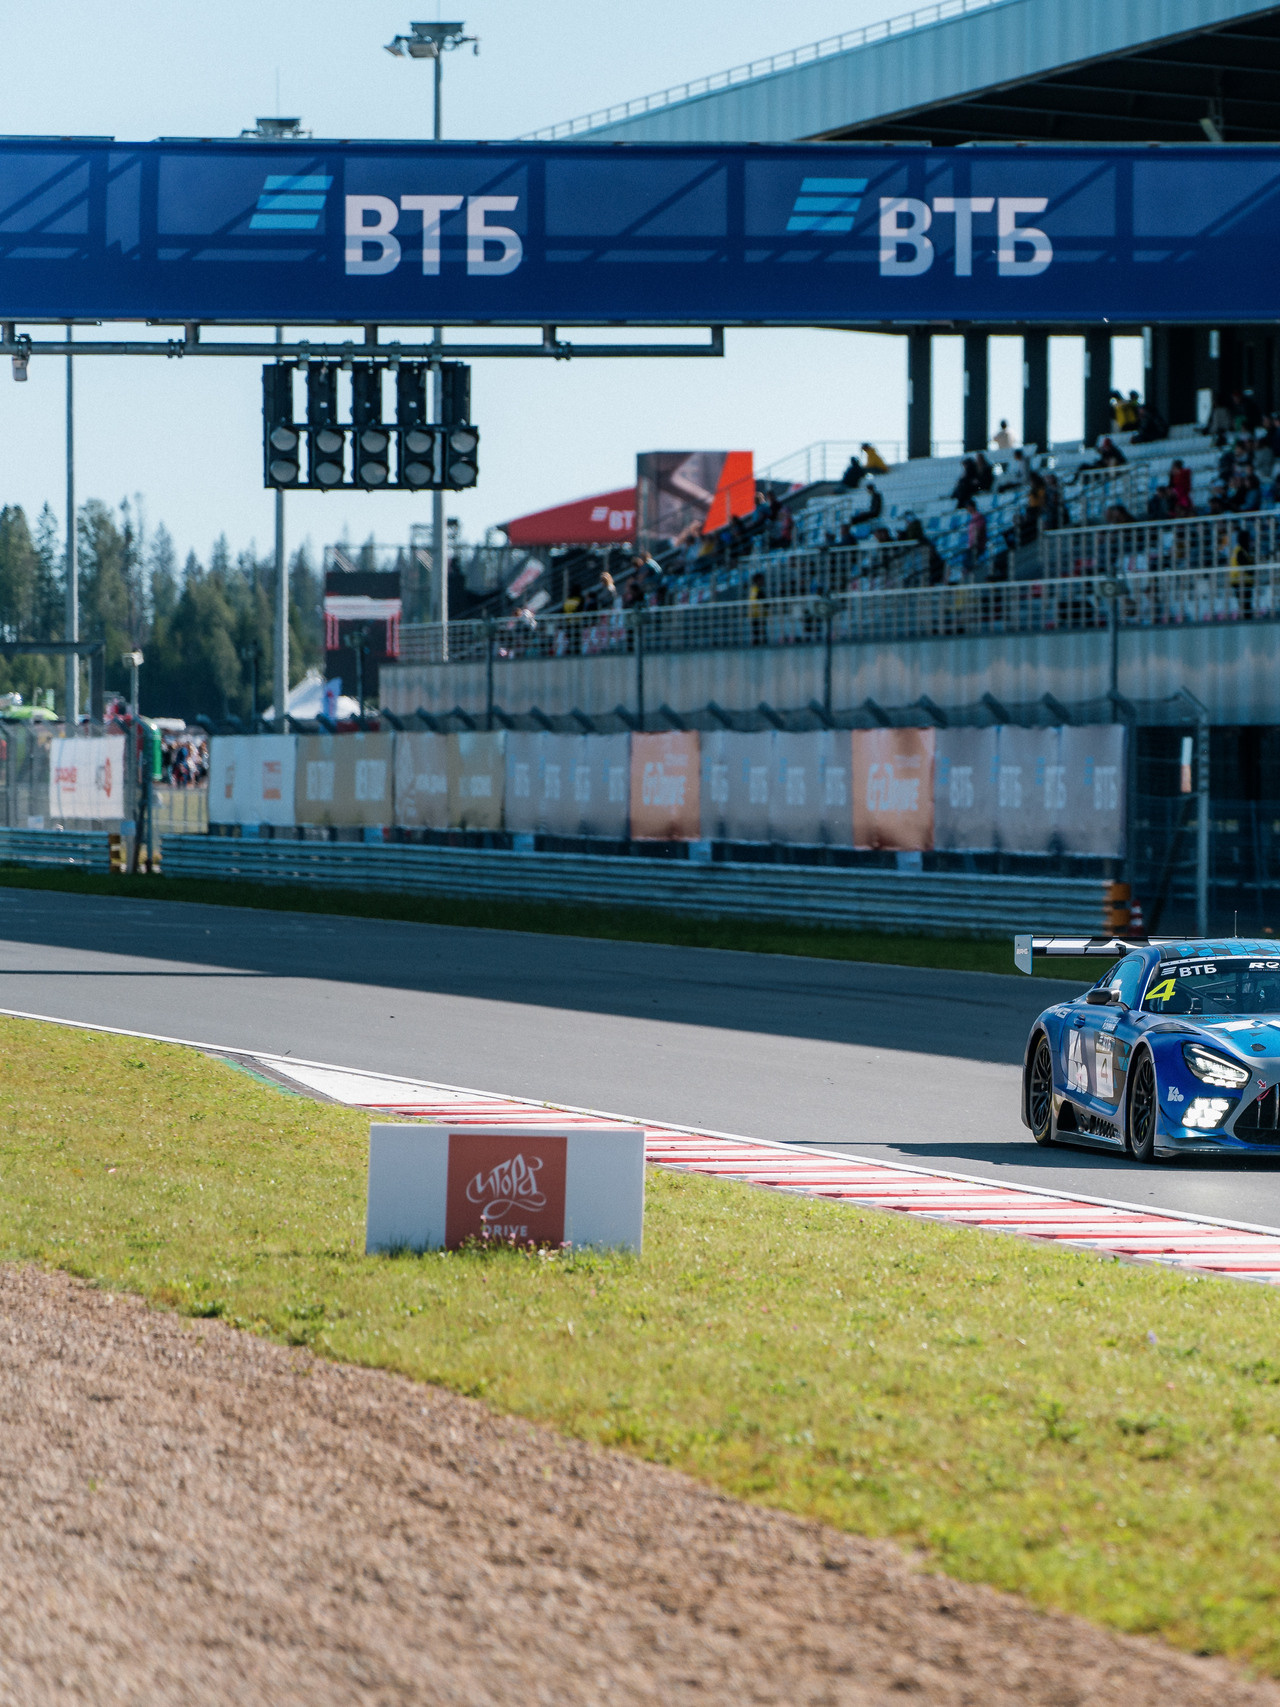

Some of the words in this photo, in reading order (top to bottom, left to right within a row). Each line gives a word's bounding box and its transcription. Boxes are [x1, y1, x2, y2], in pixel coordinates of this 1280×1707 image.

[345, 195, 523, 275] ВТБ
[879, 197, 1053, 276] ВТБ
[609, 510, 636, 530] ВТ
[1179, 964, 1217, 977] ВТБ
[1145, 979, 1176, 1001] 4
